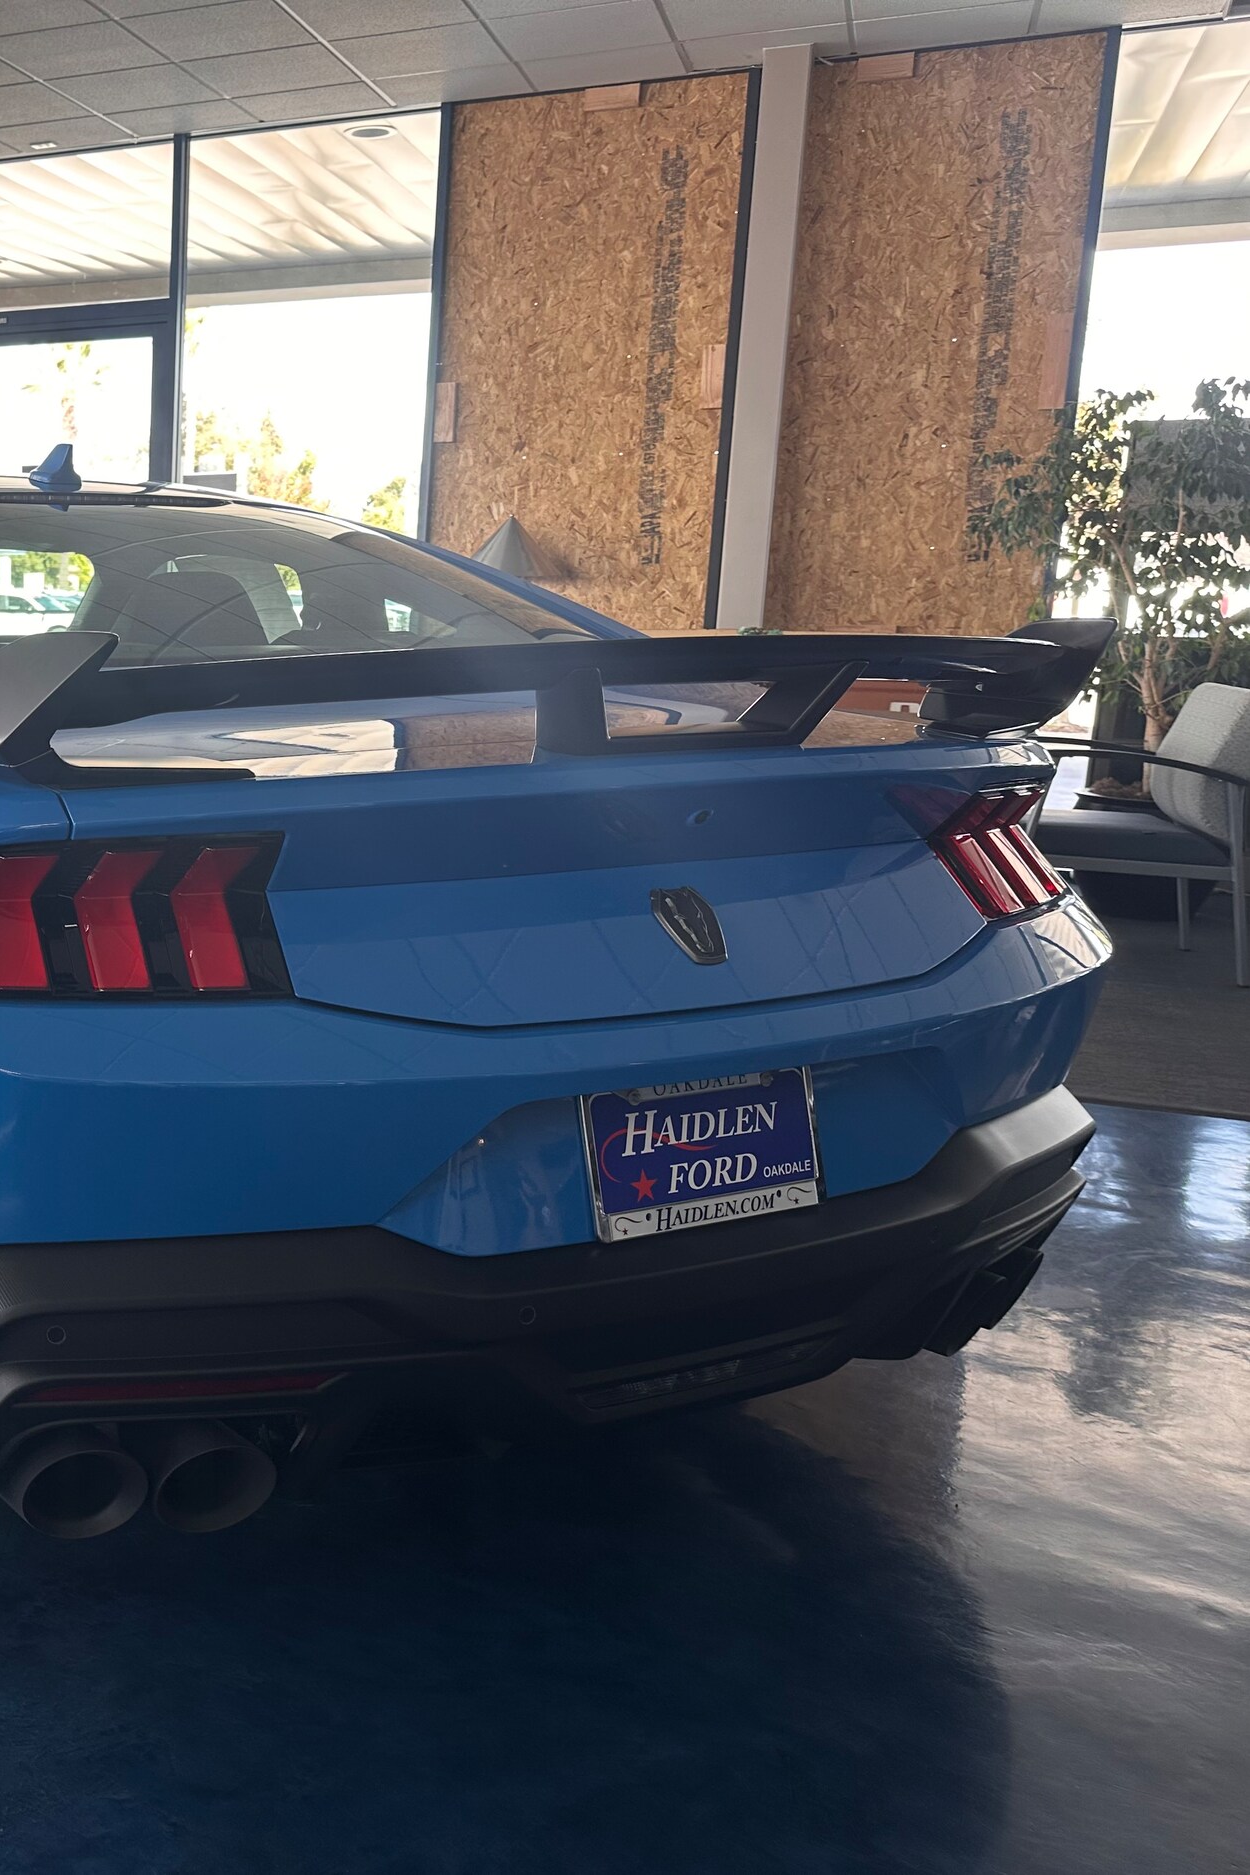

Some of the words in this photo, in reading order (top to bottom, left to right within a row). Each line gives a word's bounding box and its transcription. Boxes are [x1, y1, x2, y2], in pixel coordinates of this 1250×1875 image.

[653, 1074, 748, 1096] OAKDALE
[621, 1101, 778, 1157] HAIDLEN
[668, 1153, 758, 1194] FORD
[763, 1159, 811, 1178] OAKDALE
[655, 1193, 775, 1232] HAIDLEN.COM
